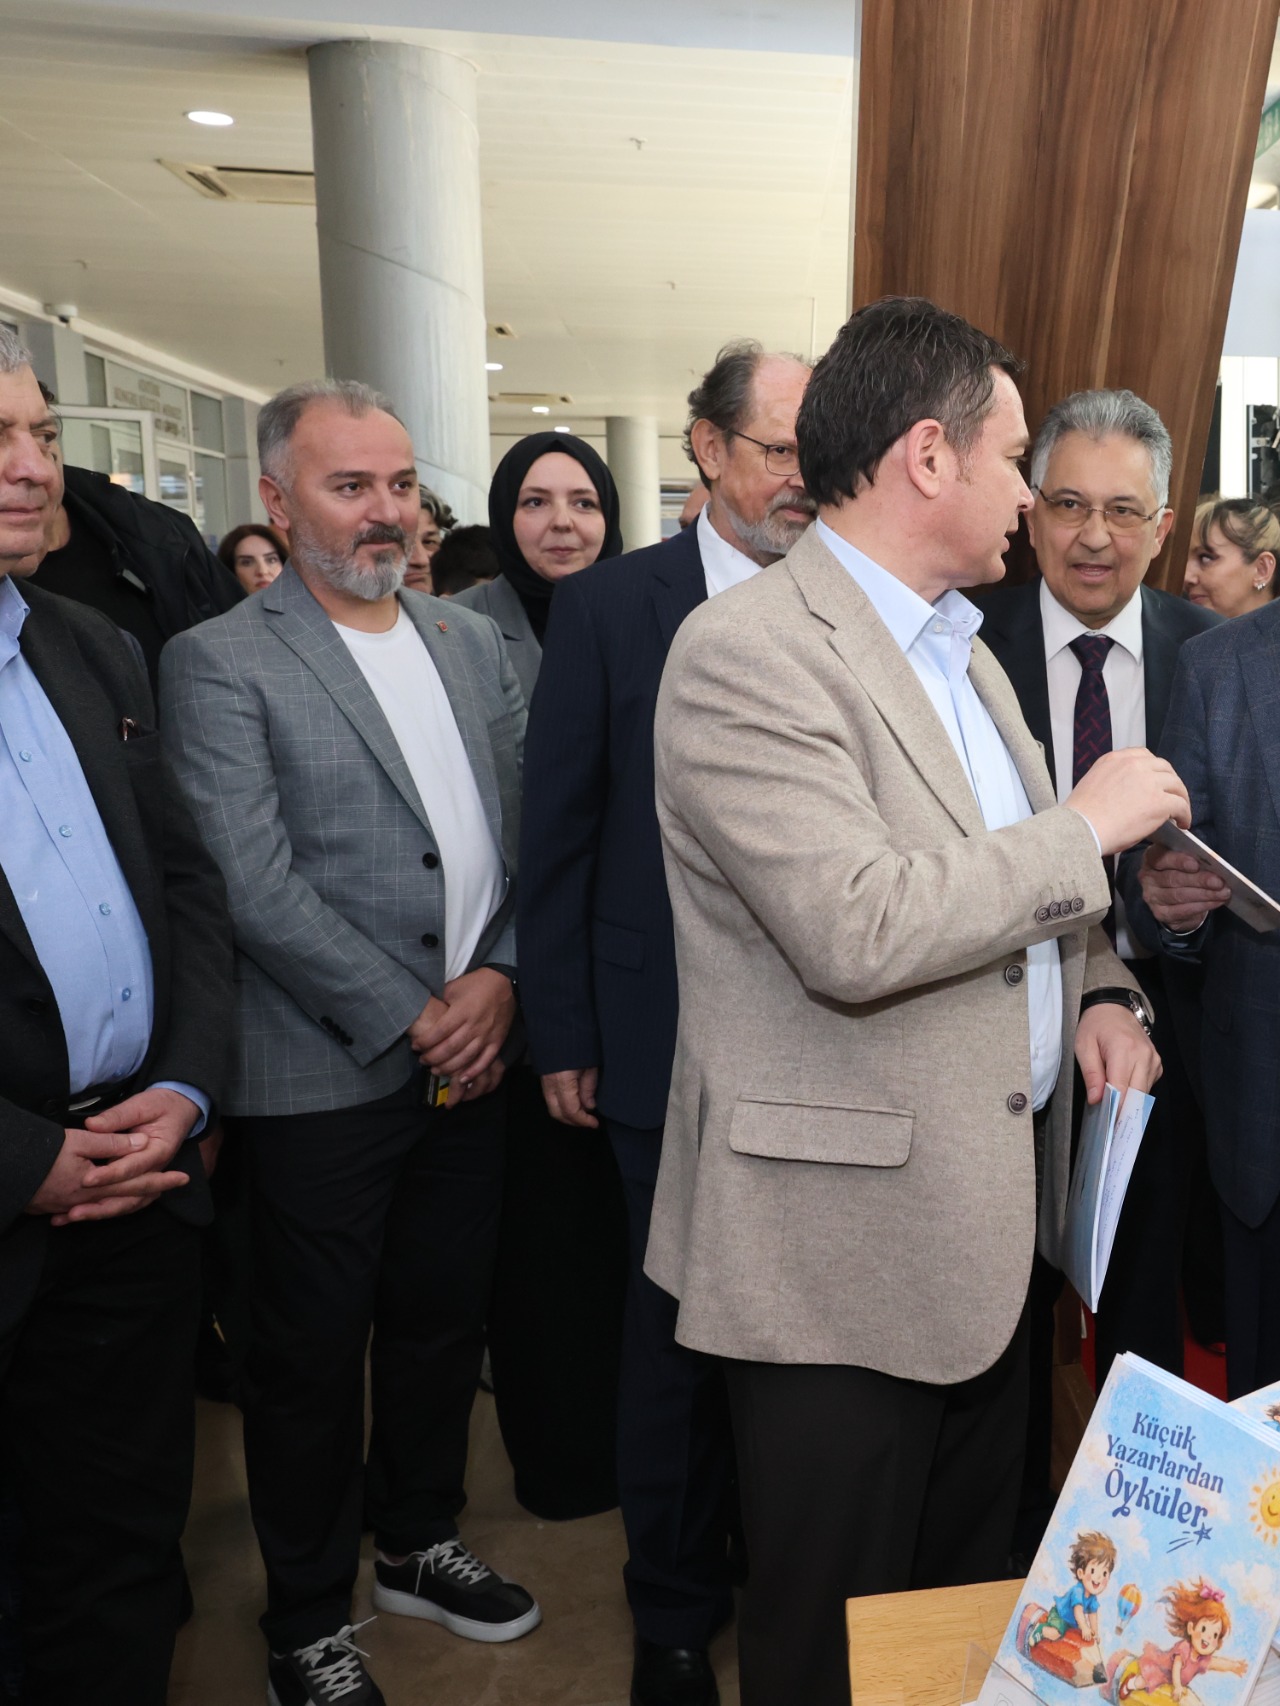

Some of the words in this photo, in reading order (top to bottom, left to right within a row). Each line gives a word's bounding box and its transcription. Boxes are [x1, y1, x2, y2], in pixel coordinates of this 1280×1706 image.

[1106, 1434, 1224, 1494] Yazarlardan
[1132, 1412, 1197, 1461] Küçük
[1105, 1462, 1208, 1527] Öyküler
